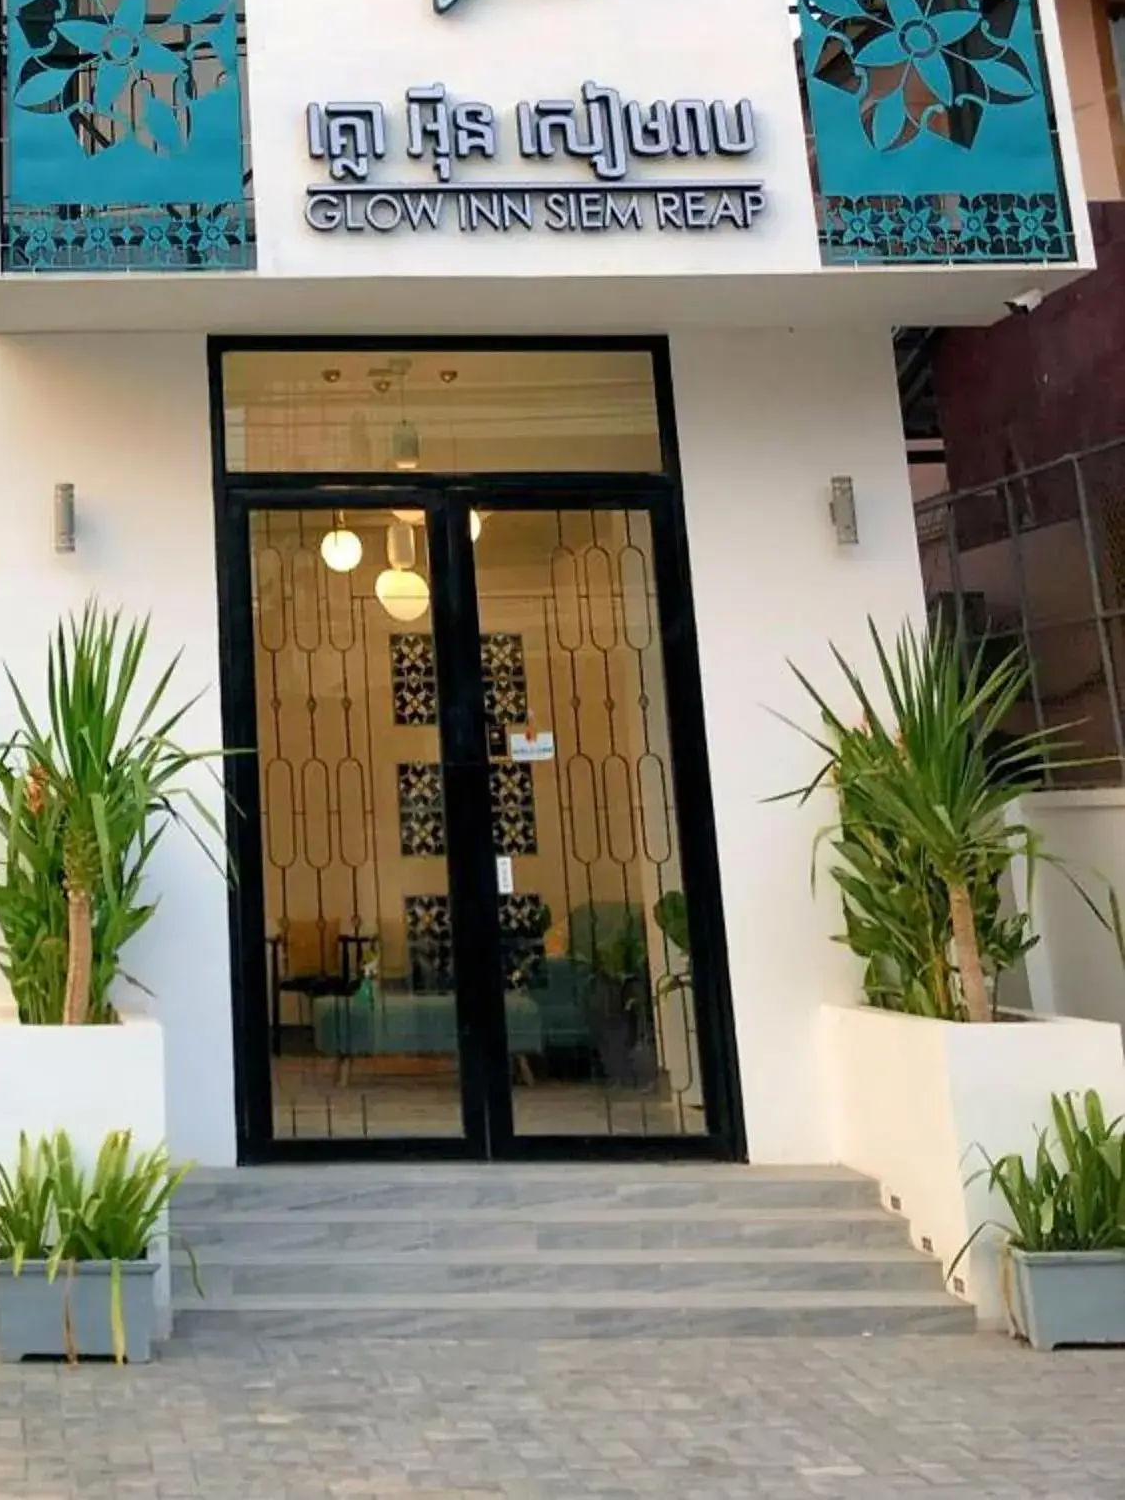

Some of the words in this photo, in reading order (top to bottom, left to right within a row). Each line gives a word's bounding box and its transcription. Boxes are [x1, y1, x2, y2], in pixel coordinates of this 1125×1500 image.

[516, 79, 757, 181] សៀមរាប
[305, 193, 443, 231] GLOW
[458, 192, 534, 231] INN
[545, 192, 643, 231] SIEM
[655, 190, 768, 230] REAP
